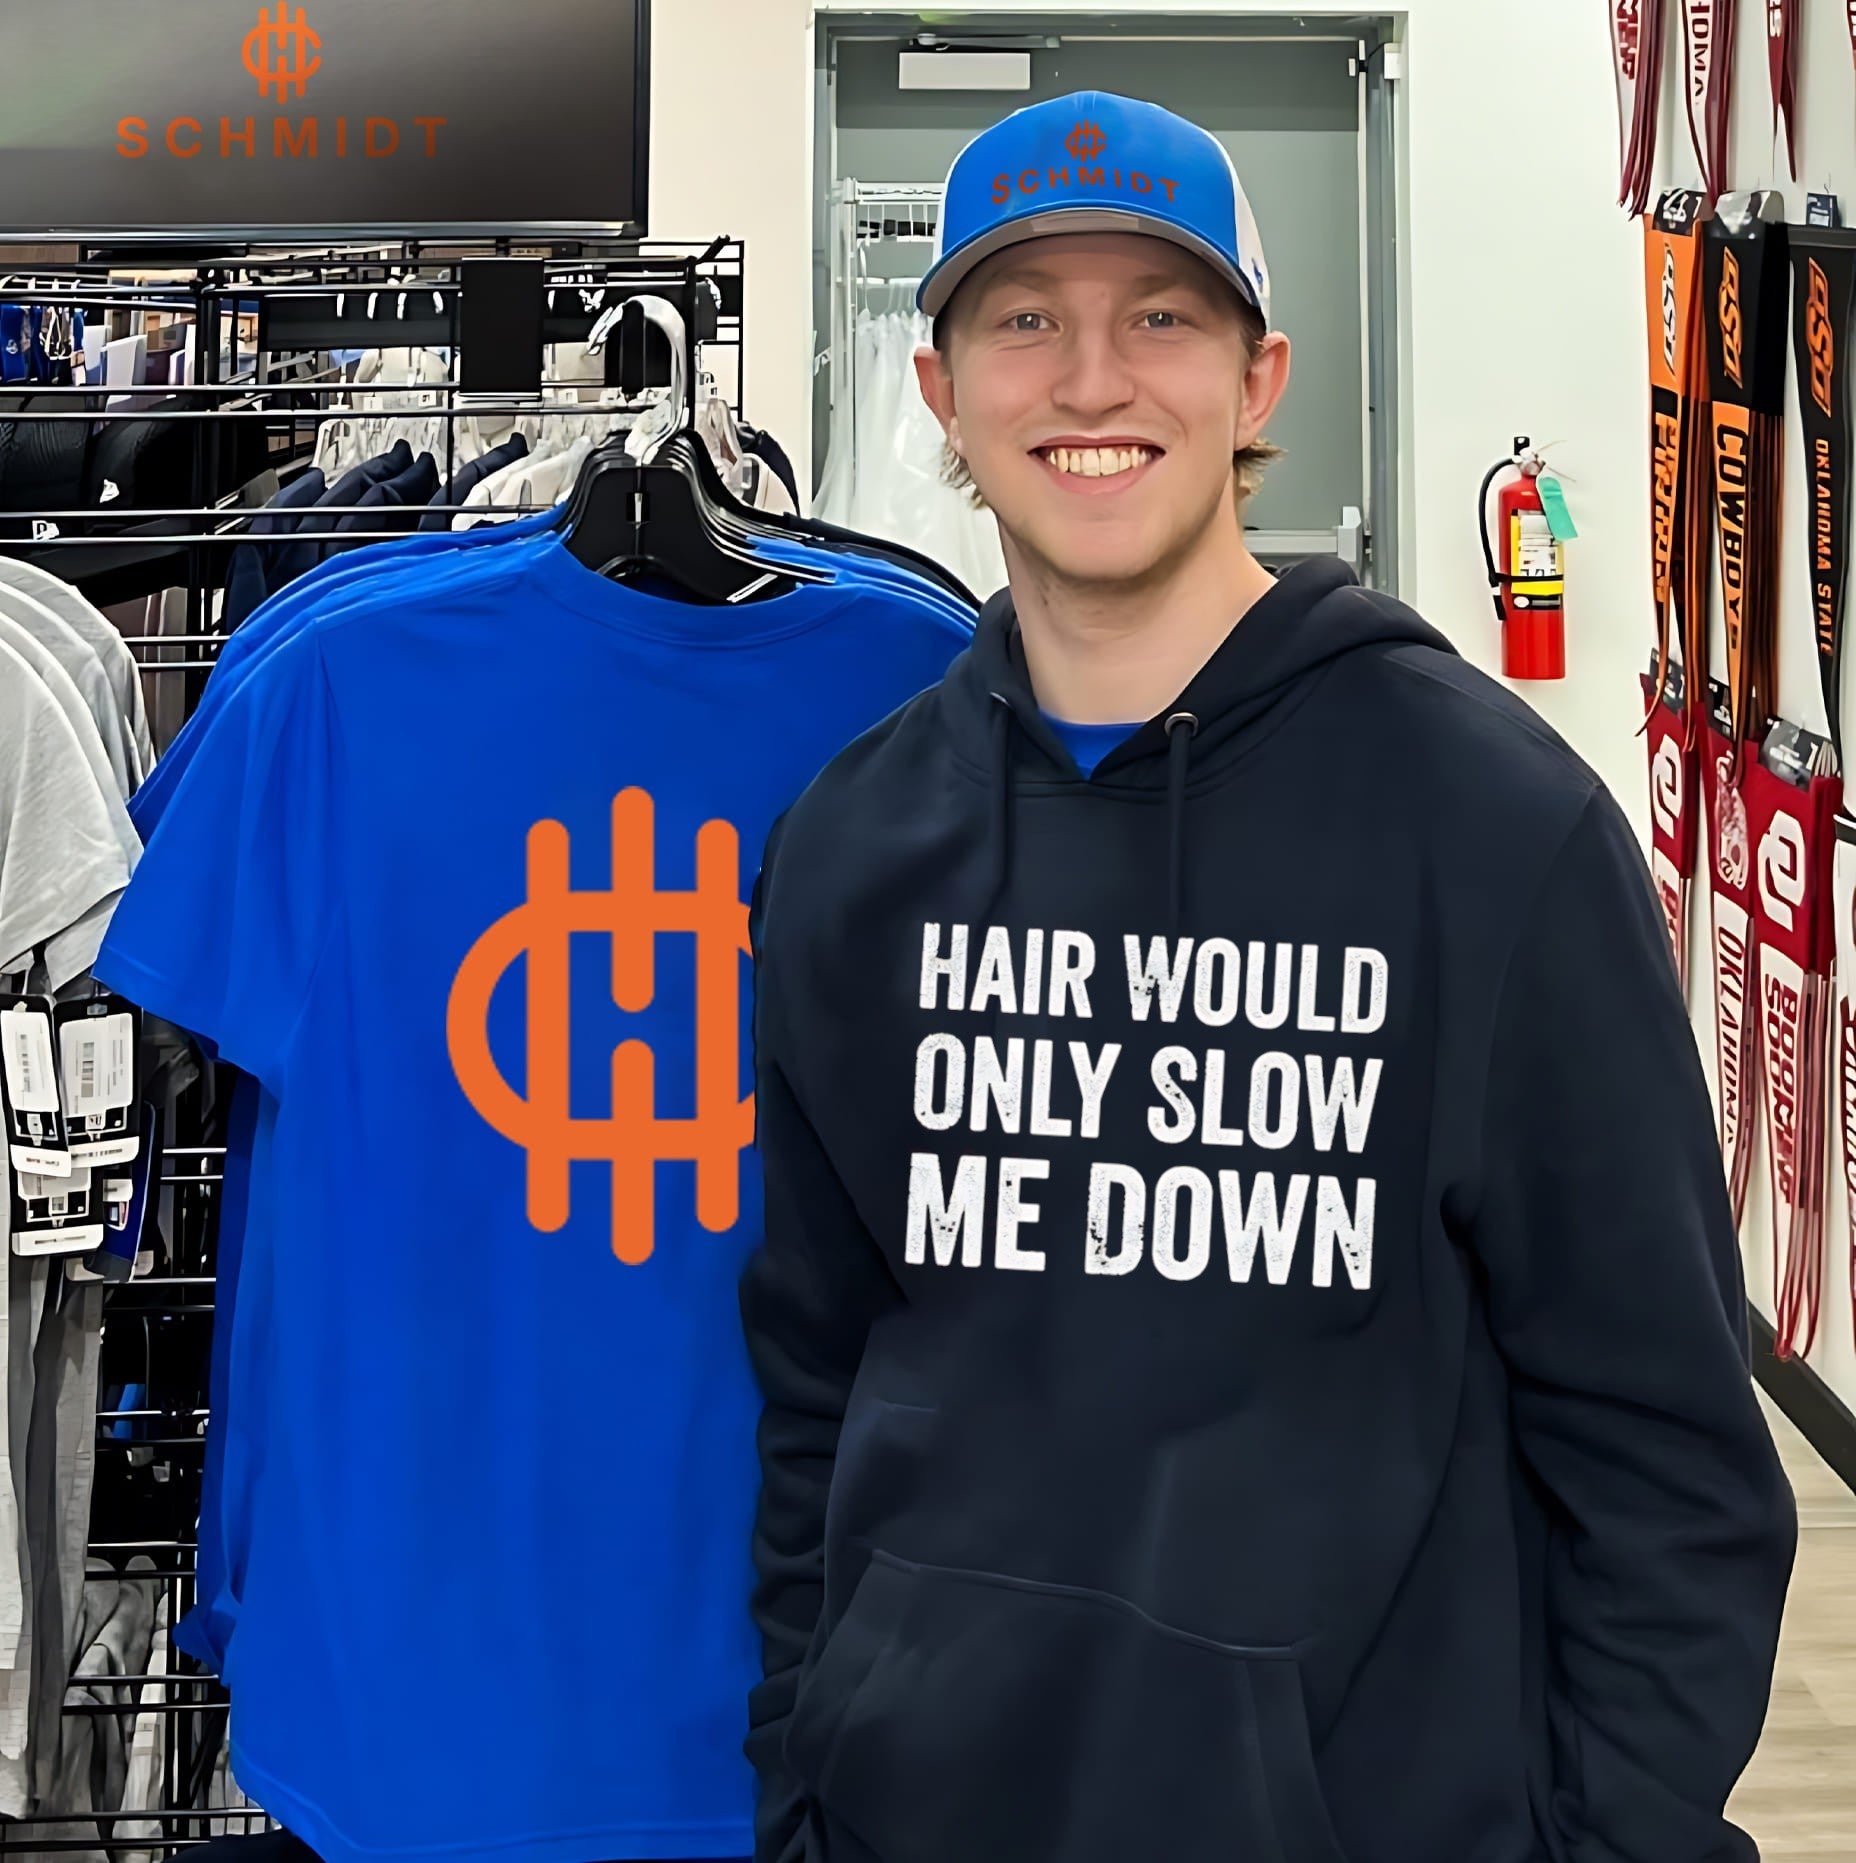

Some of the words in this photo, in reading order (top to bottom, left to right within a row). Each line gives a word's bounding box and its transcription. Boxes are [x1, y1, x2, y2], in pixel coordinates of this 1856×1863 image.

[115, 116, 447, 158] SCHMIDT
[991, 167, 1179, 204] SCHMIDT
[919, 922, 1096, 1018] HAIR
[1123, 934, 1389, 1034] WOULD
[913, 1032, 1122, 1139] ONLY
[1147, 1045, 1383, 1153] SLOW
[905, 1152, 1050, 1272] ME
[1085, 1162, 1377, 1290] DOWN
